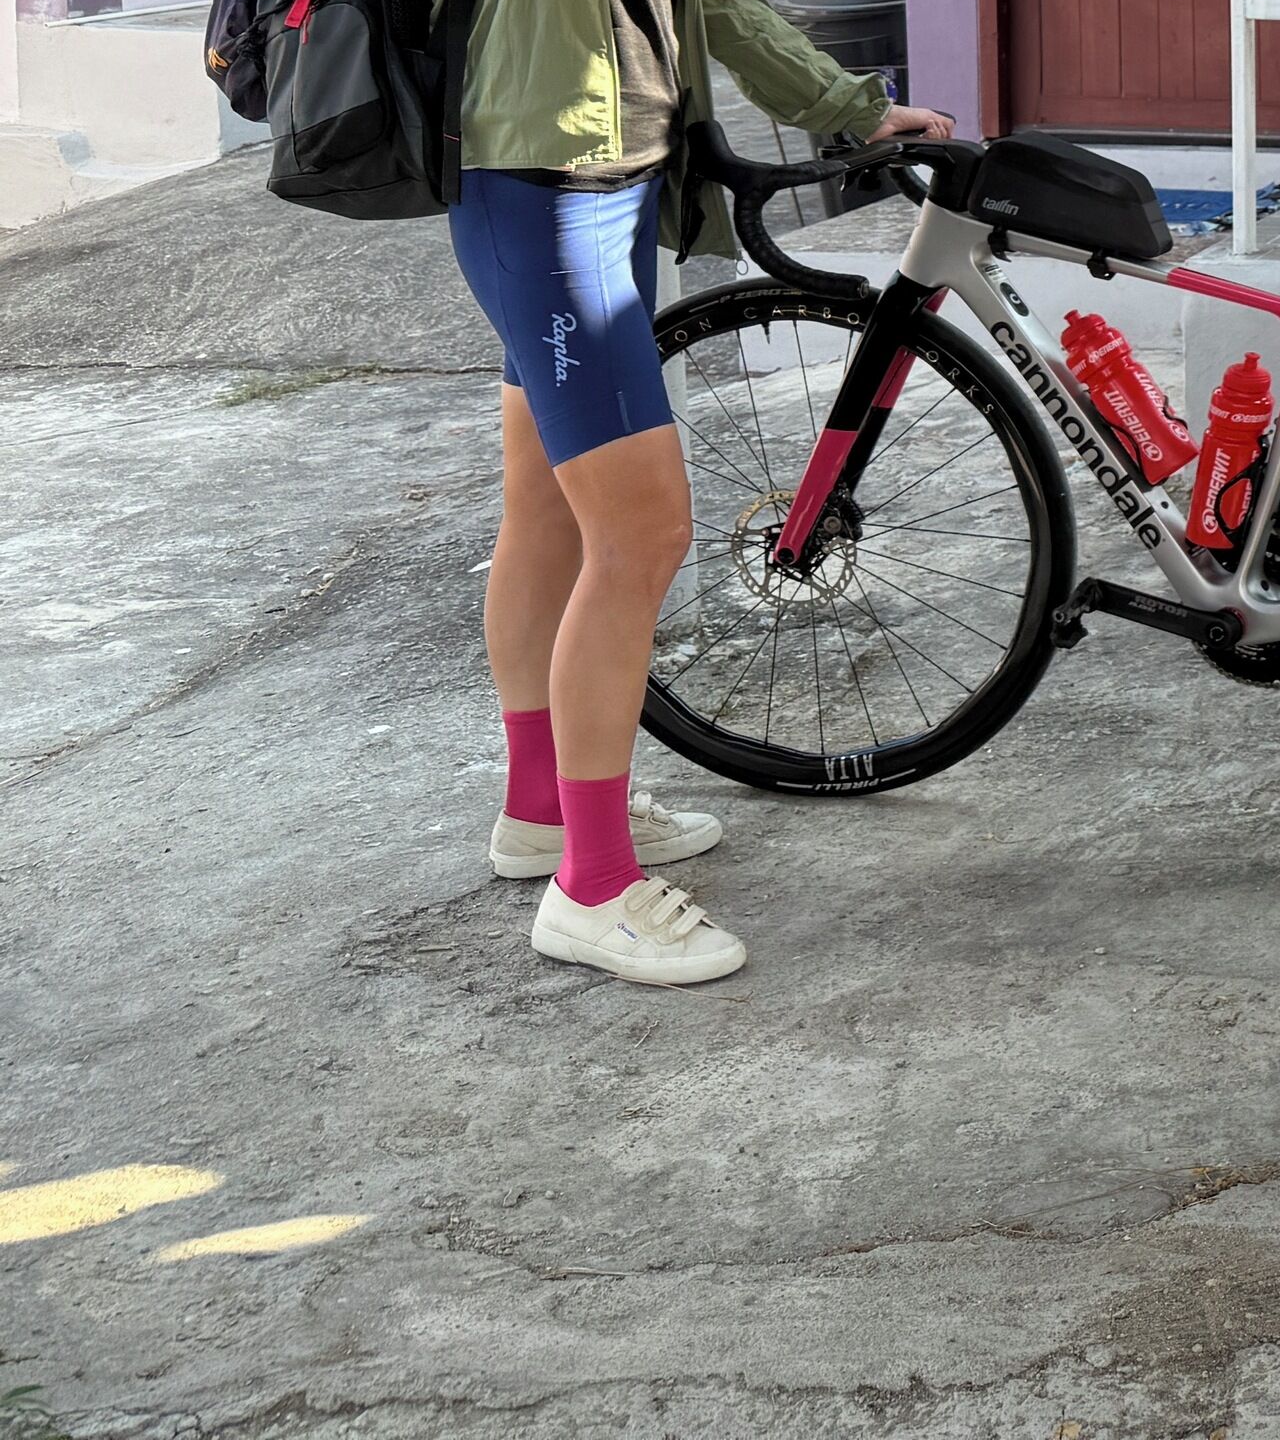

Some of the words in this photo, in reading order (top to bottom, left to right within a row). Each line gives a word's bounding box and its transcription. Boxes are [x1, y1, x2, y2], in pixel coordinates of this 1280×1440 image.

[742, 303, 861, 326] CARBO
[925, 349, 996, 415] ORKS
[989, 321, 1162, 550] cannondale
[1103, 389, 1151, 443] ENERVIT
